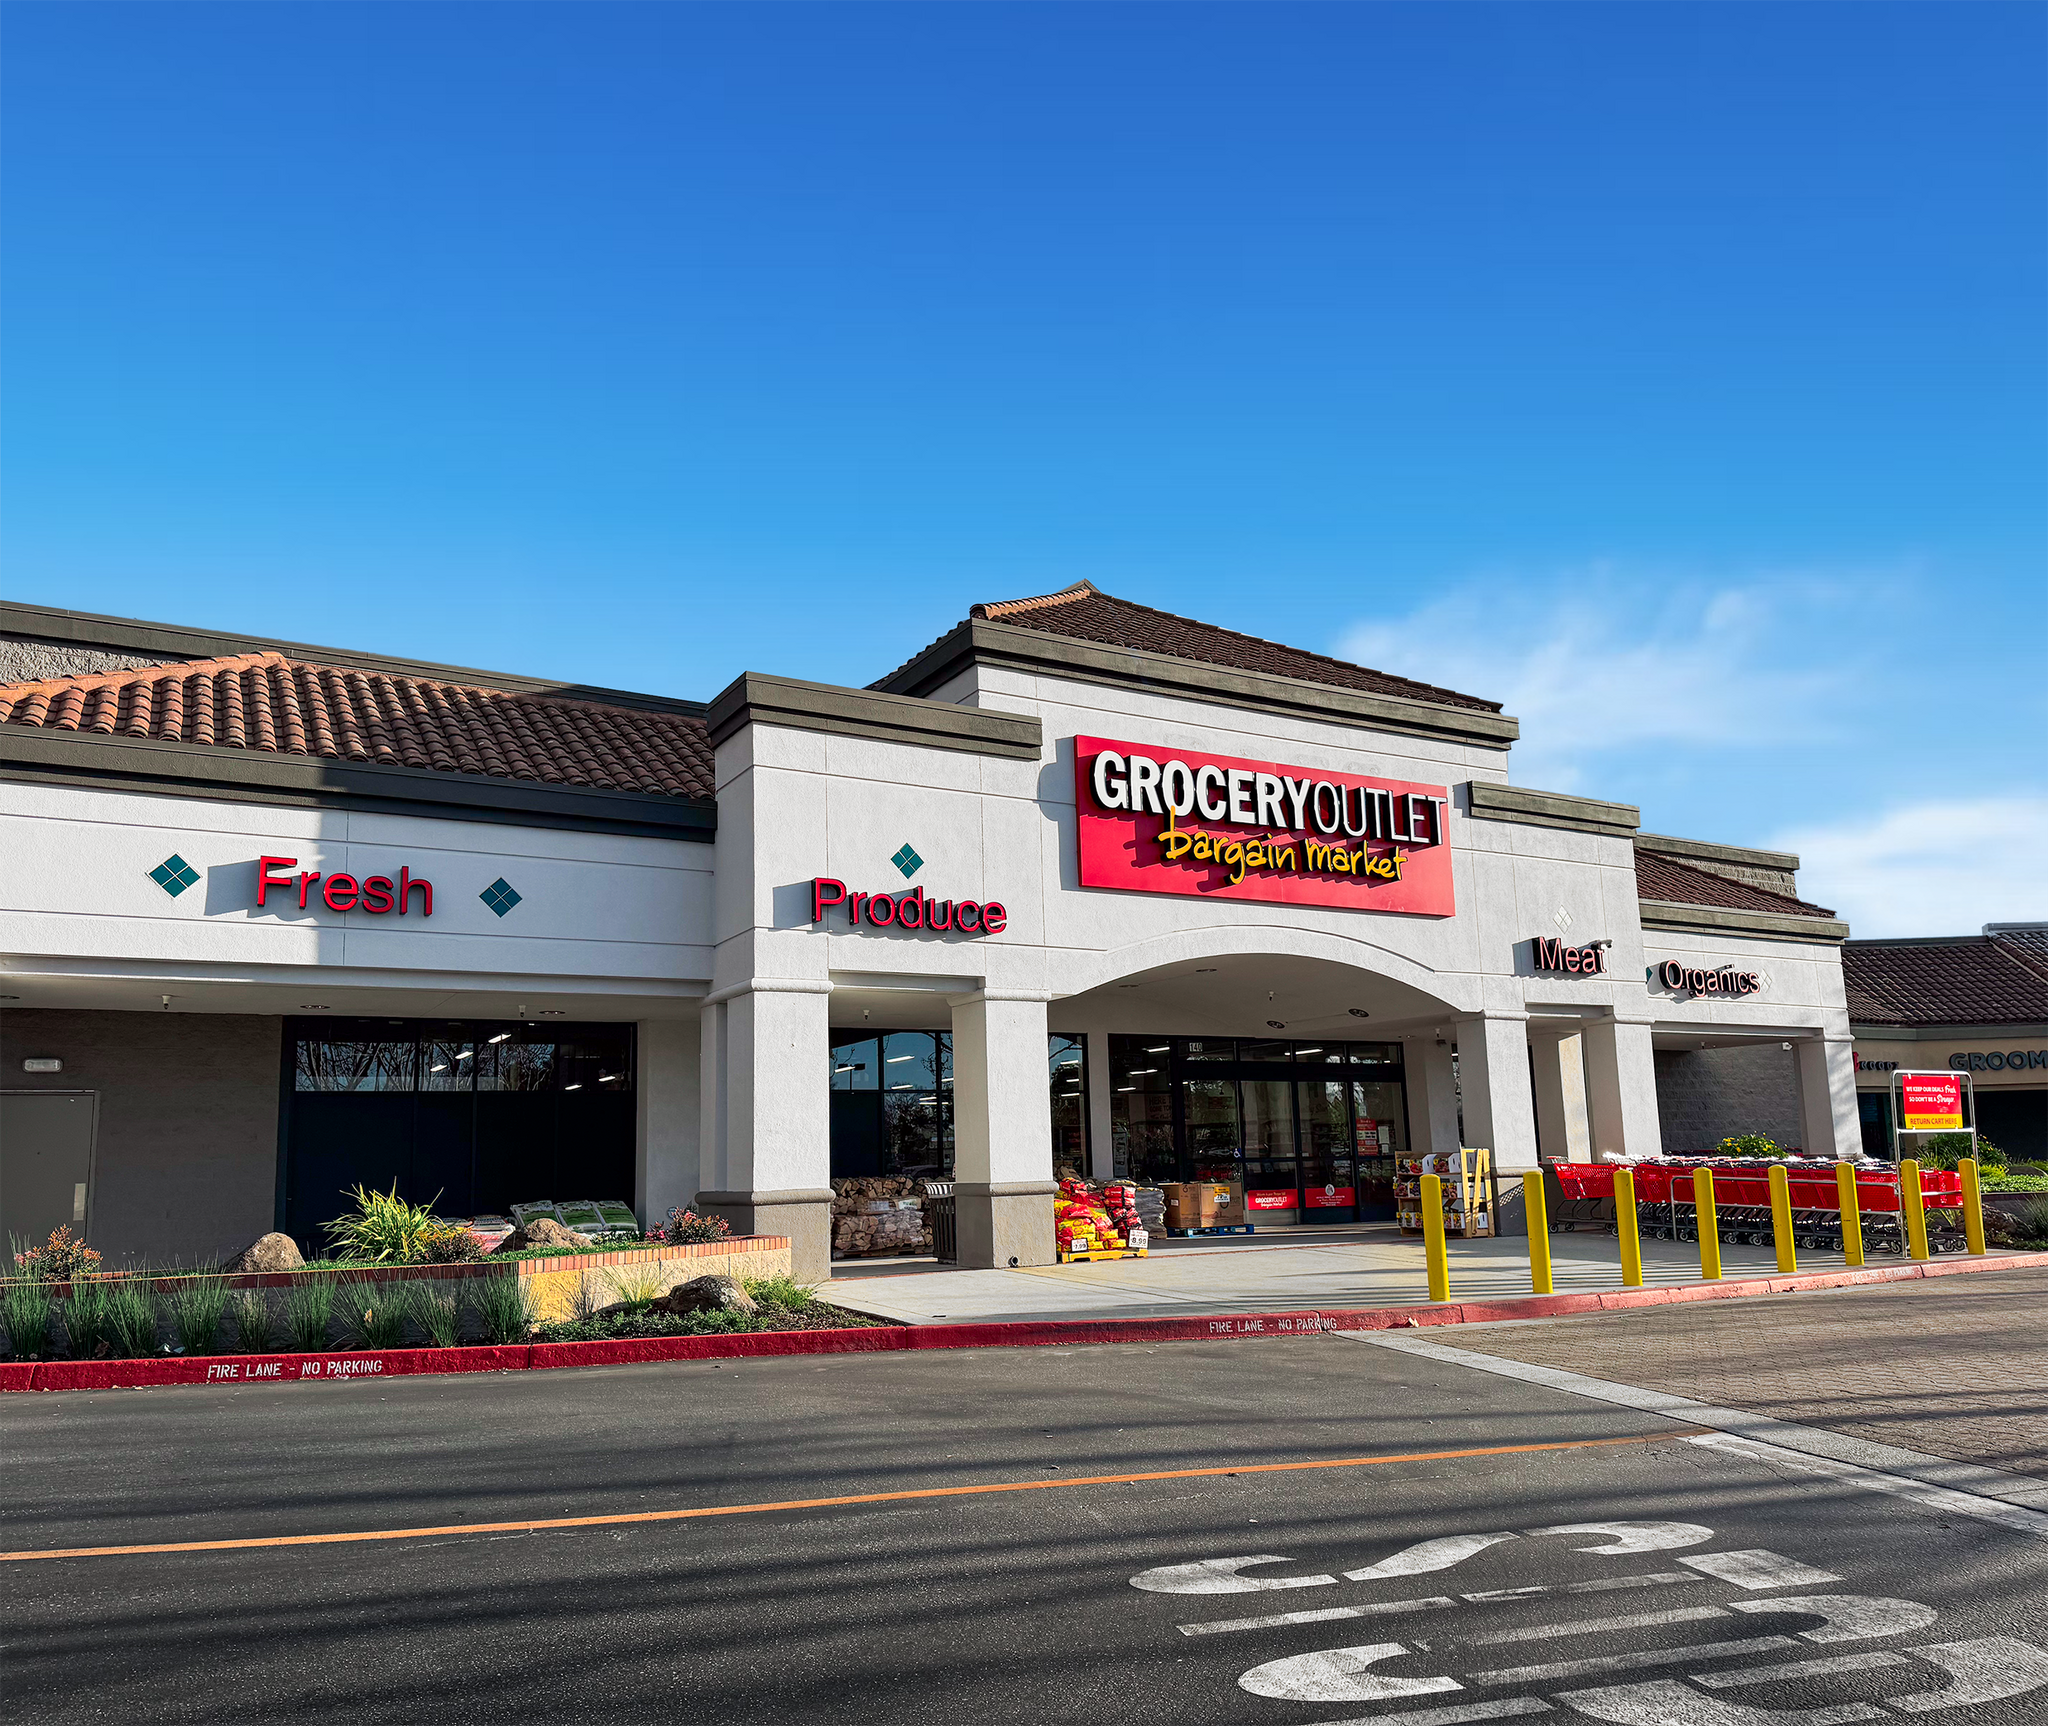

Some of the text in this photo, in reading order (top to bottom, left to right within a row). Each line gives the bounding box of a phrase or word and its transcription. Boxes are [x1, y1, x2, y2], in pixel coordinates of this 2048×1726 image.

[1158, 805, 1297, 885] bargain
[257, 855, 433, 916] Fresh
[812, 877, 1007, 935] Produce
[1536, 936, 1608, 975] Meat
[1661, 958, 1761, 999] Organics
[1949, 1050, 2048, 1071] GROOM
[1209, 1321, 1233, 1333] FIRE
[1238, 1320, 1265, 1332] LANE
[1278, 1318, 1292, 1330] NO
[1296, 1317, 1337, 1330] PARKING
[207, 1364, 240, 1378] FIRE
[245, 1363, 283, 1377] LANE
[302, 1361, 321, 1375] NO
[326, 1359, 383, 1374] PARKING
